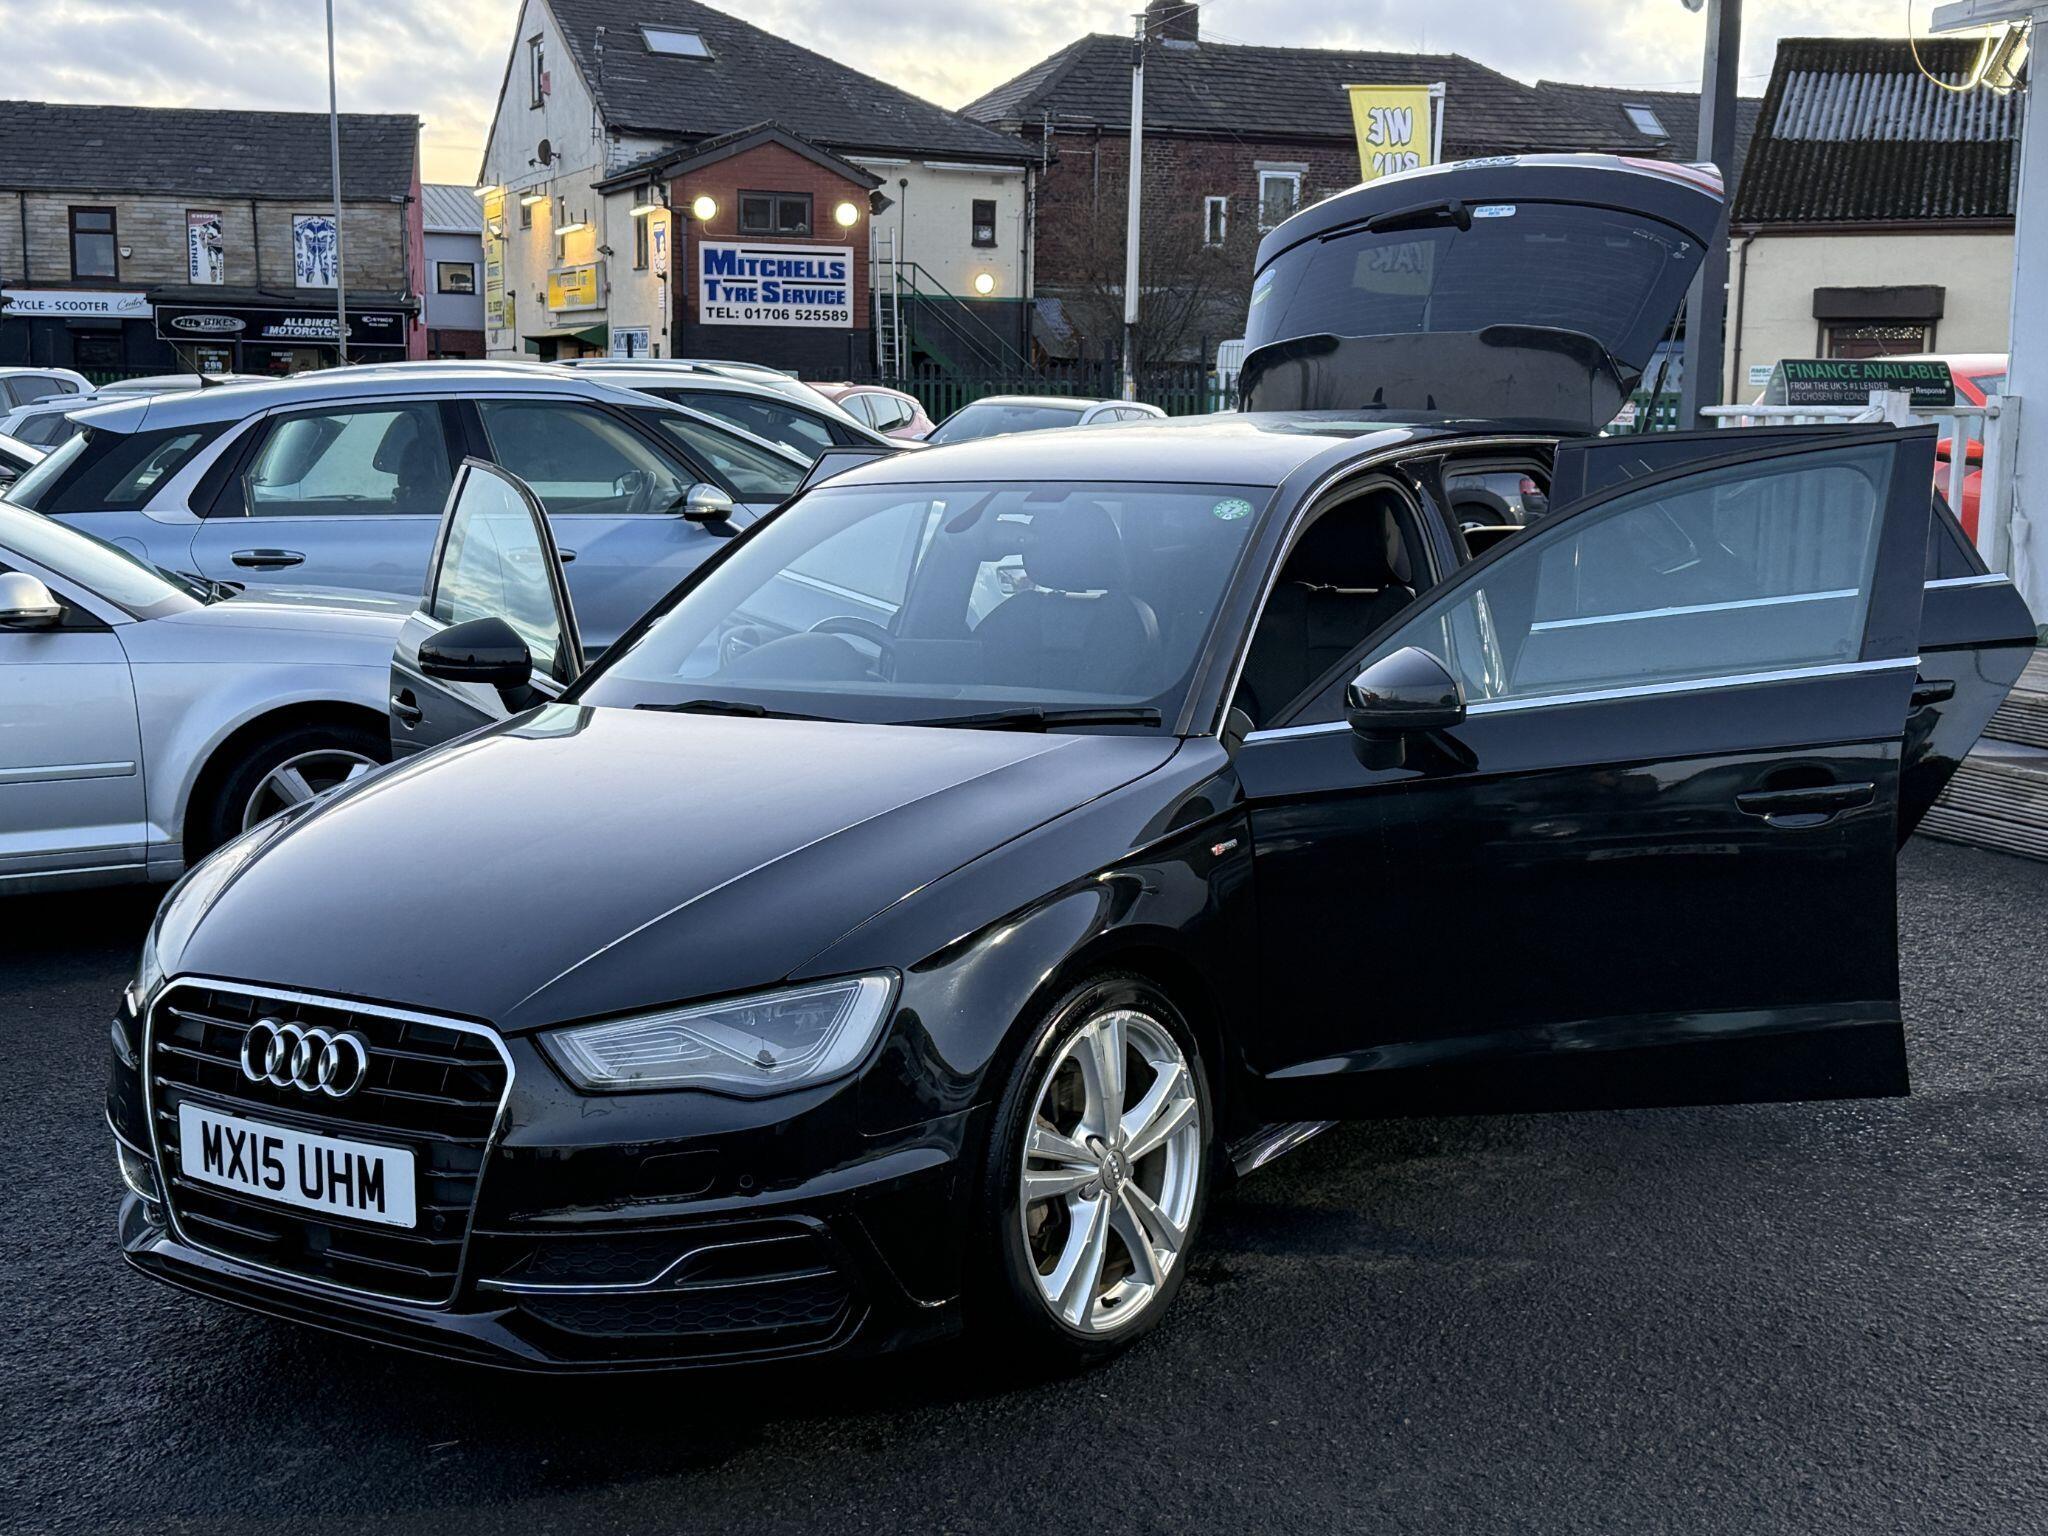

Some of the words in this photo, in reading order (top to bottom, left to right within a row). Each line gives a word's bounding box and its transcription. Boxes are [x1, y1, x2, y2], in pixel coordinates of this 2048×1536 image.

[190, 228, 199, 277] LEATHERS
[703, 248, 846, 280] MITCHELLS
[704, 279, 757, 303] TYRE
[762, 281, 846, 305] SERVICE
[55, 301, 109, 311] SCOOTER
[706, 307, 739, 319] TEL:
[744, 308, 790, 320] 01706
[795, 309, 848, 322] 525589
[180, 319, 197, 328] ALL
[204, 317, 237, 327] BIKES
[1785, 363, 1861, 379] FINANCE
[1864, 364, 1950, 380] AVAILABLE
[1790, 382, 1812, 391] FROM
[1813, 382, 1829, 390] THE
[1830, 382, 1849, 390] UK'S
[1859, 382, 1889, 390] LENDER
[1915, 386, 1947, 395] Response
[1790, 392, 1800, 401] AS
[1802, 392, 1832, 401] CHOSEN
[201, 1120, 285, 1192] MX15
[297, 1143, 386, 1214] UHM
